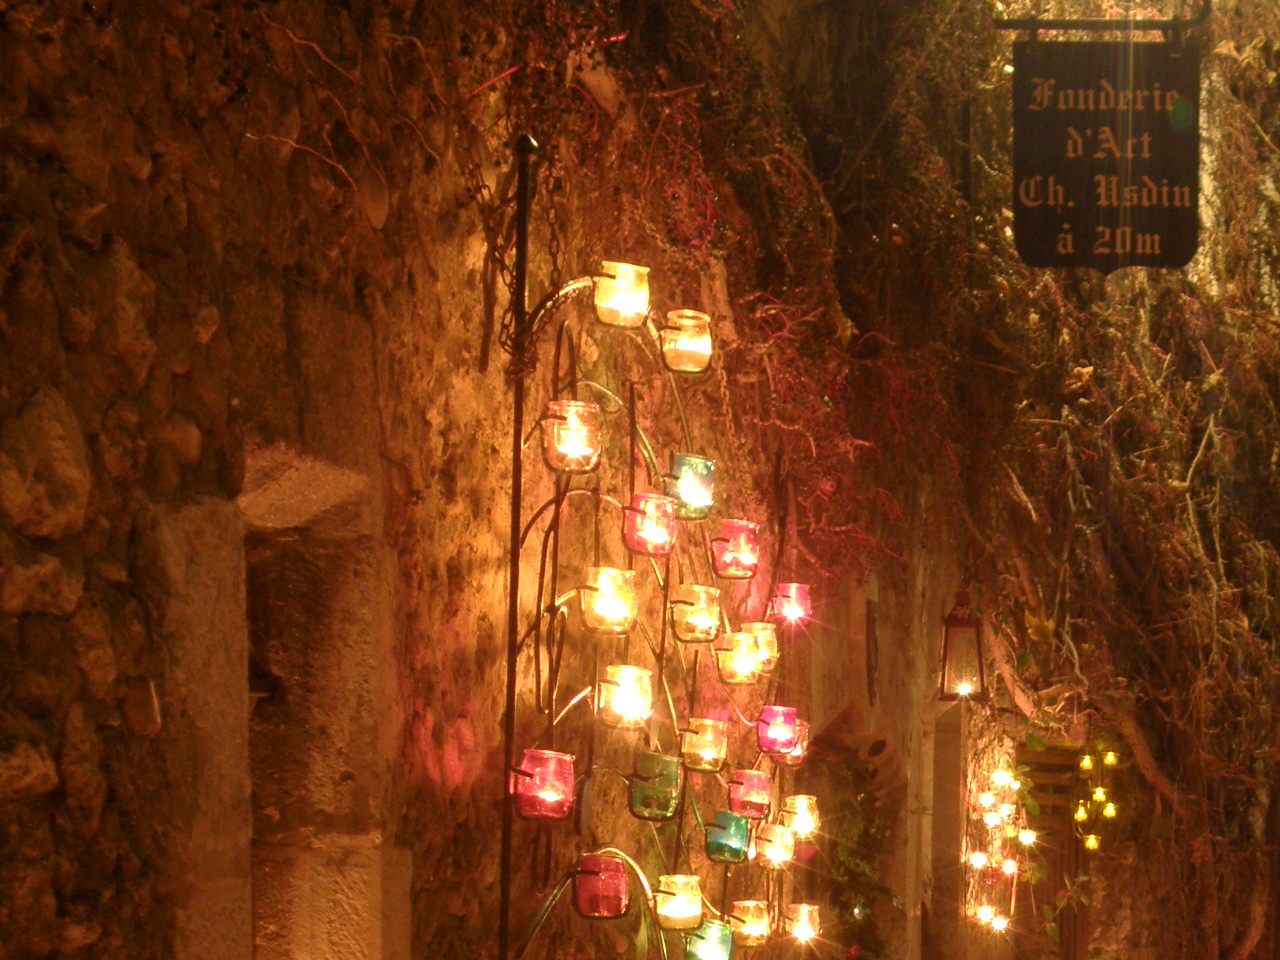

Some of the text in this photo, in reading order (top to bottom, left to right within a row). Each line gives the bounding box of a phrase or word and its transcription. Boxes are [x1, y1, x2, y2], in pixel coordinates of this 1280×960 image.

[1027, 78, 1180, 112] Fonderie
[1066, 126, 1153, 160] d'Art
[1019, 174, 1193, 215] Ch. Usdin
[1093, 225, 1162, 256] 20m
